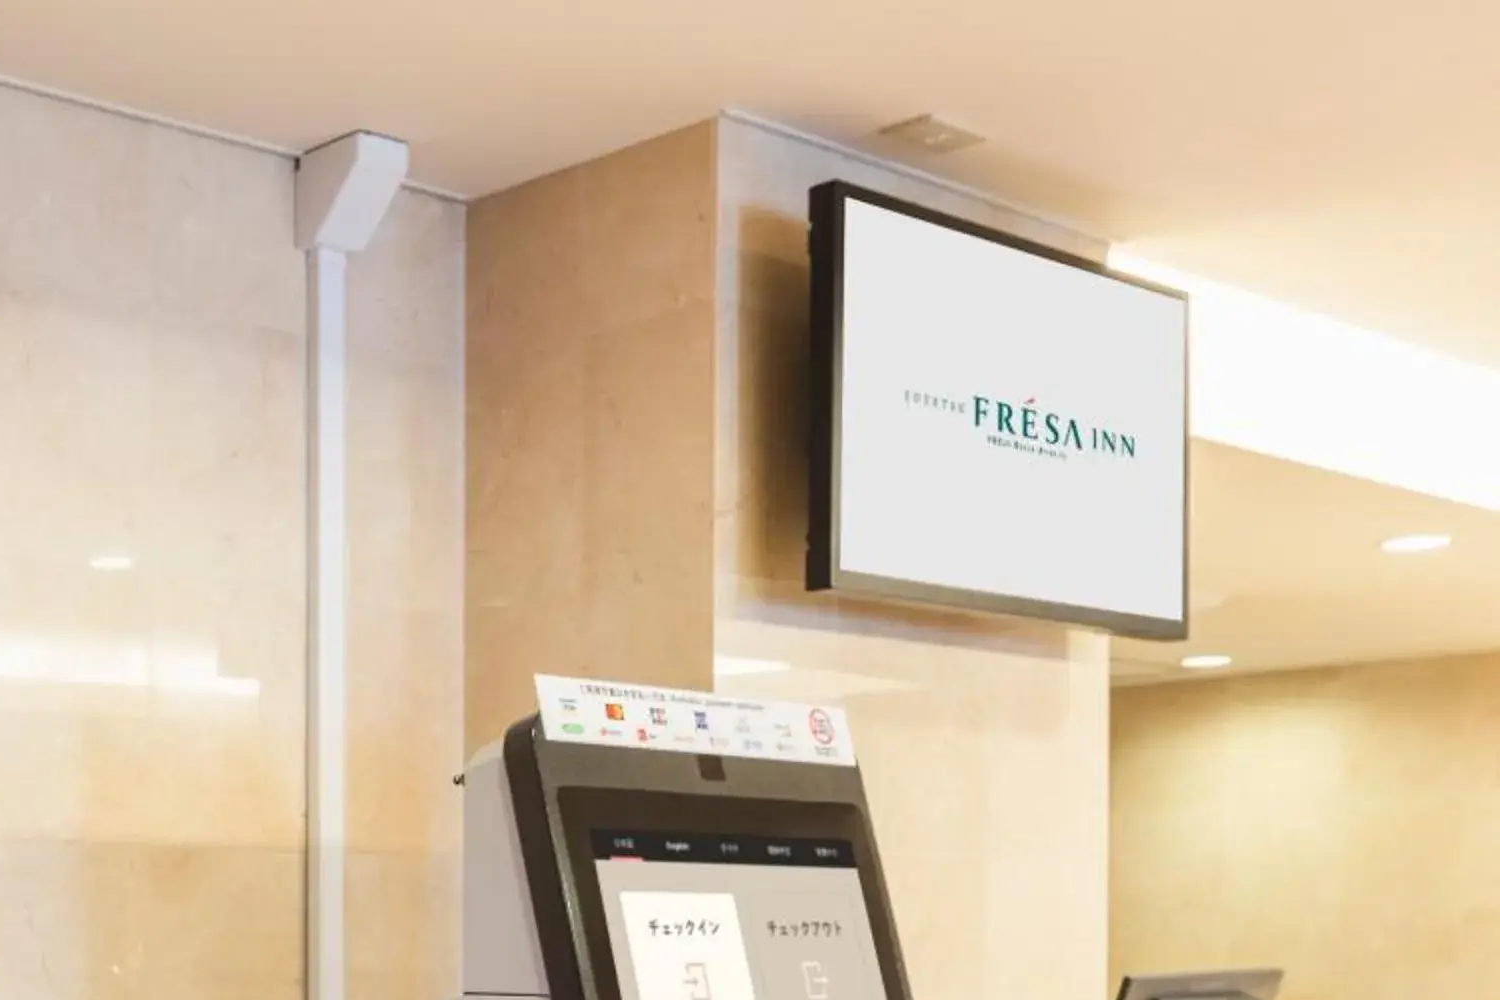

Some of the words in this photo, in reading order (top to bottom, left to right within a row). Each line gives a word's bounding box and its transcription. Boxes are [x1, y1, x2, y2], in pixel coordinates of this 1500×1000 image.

[972, 394, 1083, 450] FRÉSA
[1091, 427, 1136, 457] INN
[648, 918, 720, 937] チェックイン
[766, 919, 842, 937] チェックアウト
